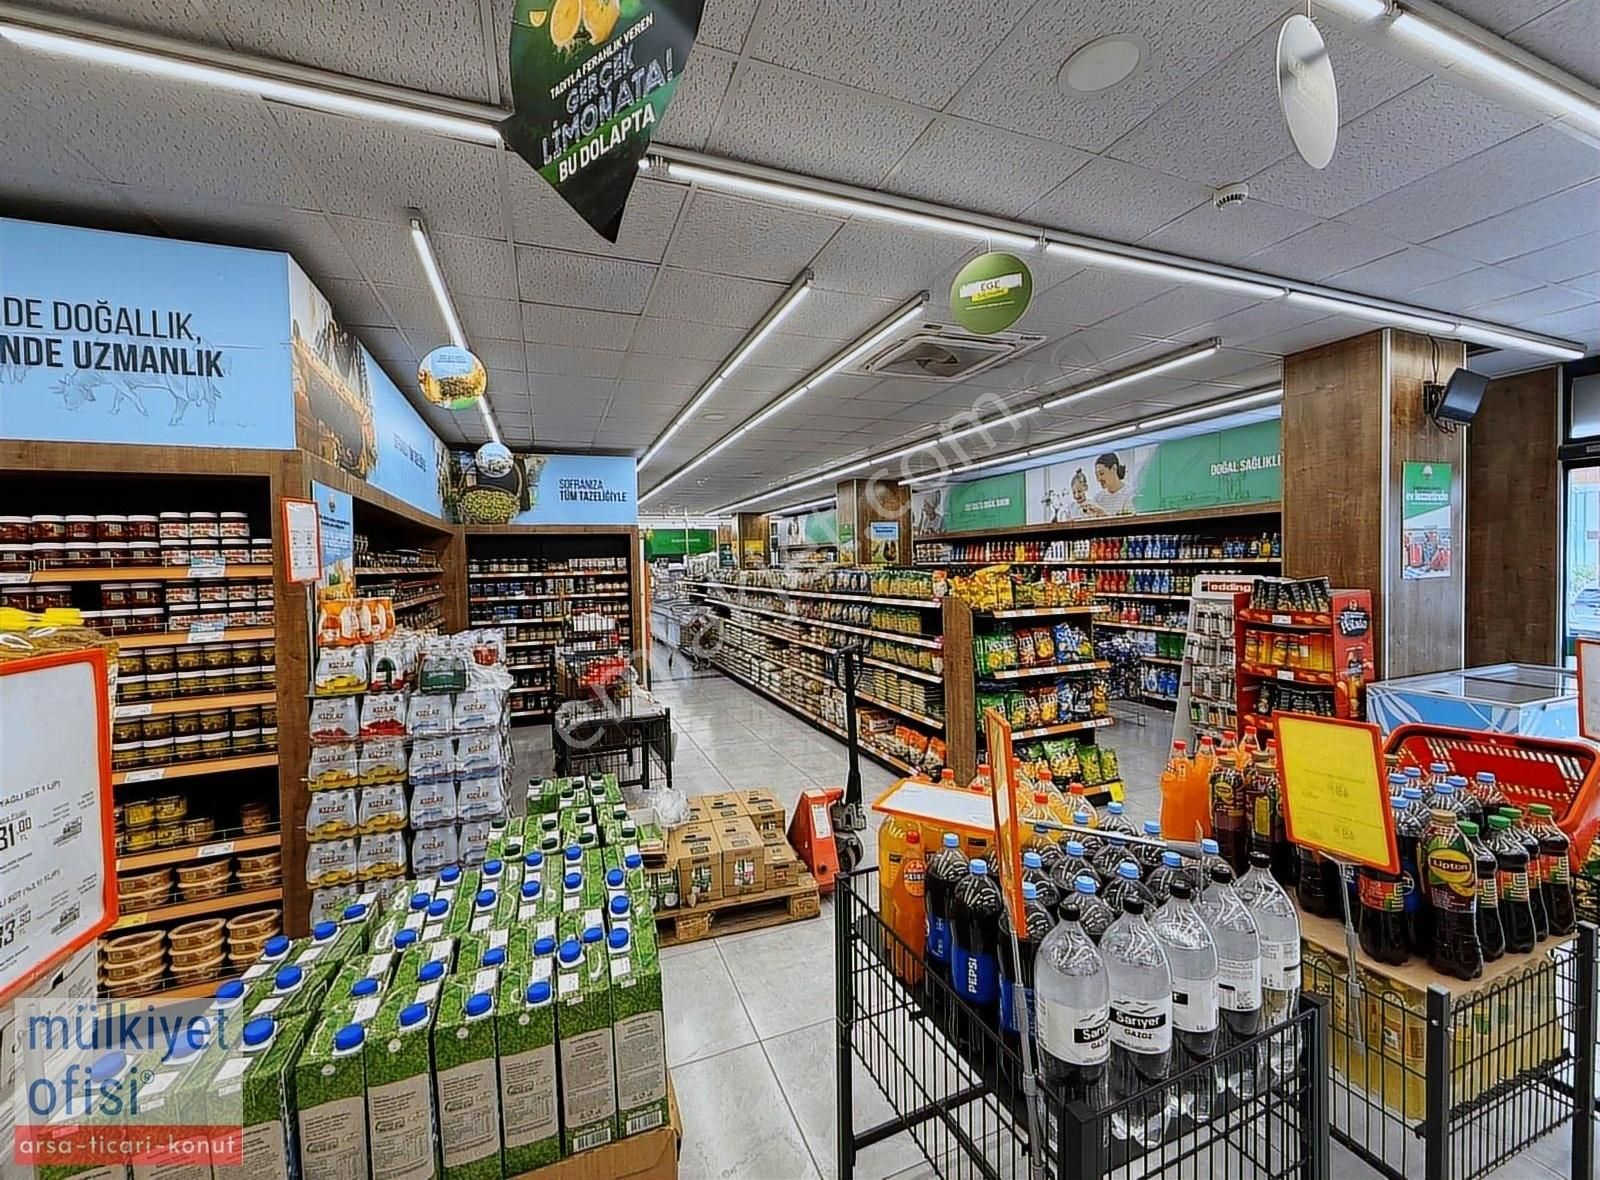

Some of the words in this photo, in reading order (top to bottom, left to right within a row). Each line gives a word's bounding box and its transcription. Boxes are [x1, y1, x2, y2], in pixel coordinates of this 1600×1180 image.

[582, 35, 624, 76] FERAHLIK
[623, 12, 654, 44] VEREN
[566, 45, 635, 114] GERÇEK
[541, 48, 673, 165] LİMONATA!
[558, 155, 578, 182] BU
[580, 103, 657, 169] DOLAPTA
[53, 299, 201, 344] DOĞALLIK,
[0, 335, 63, 368] NDE
[72, 340, 223, 377] UZMANLIK
[1211, 582, 1251, 593] edding
[1432, 858, 1470, 873] Lipton
[968, 957, 978, 993] PEPSI
